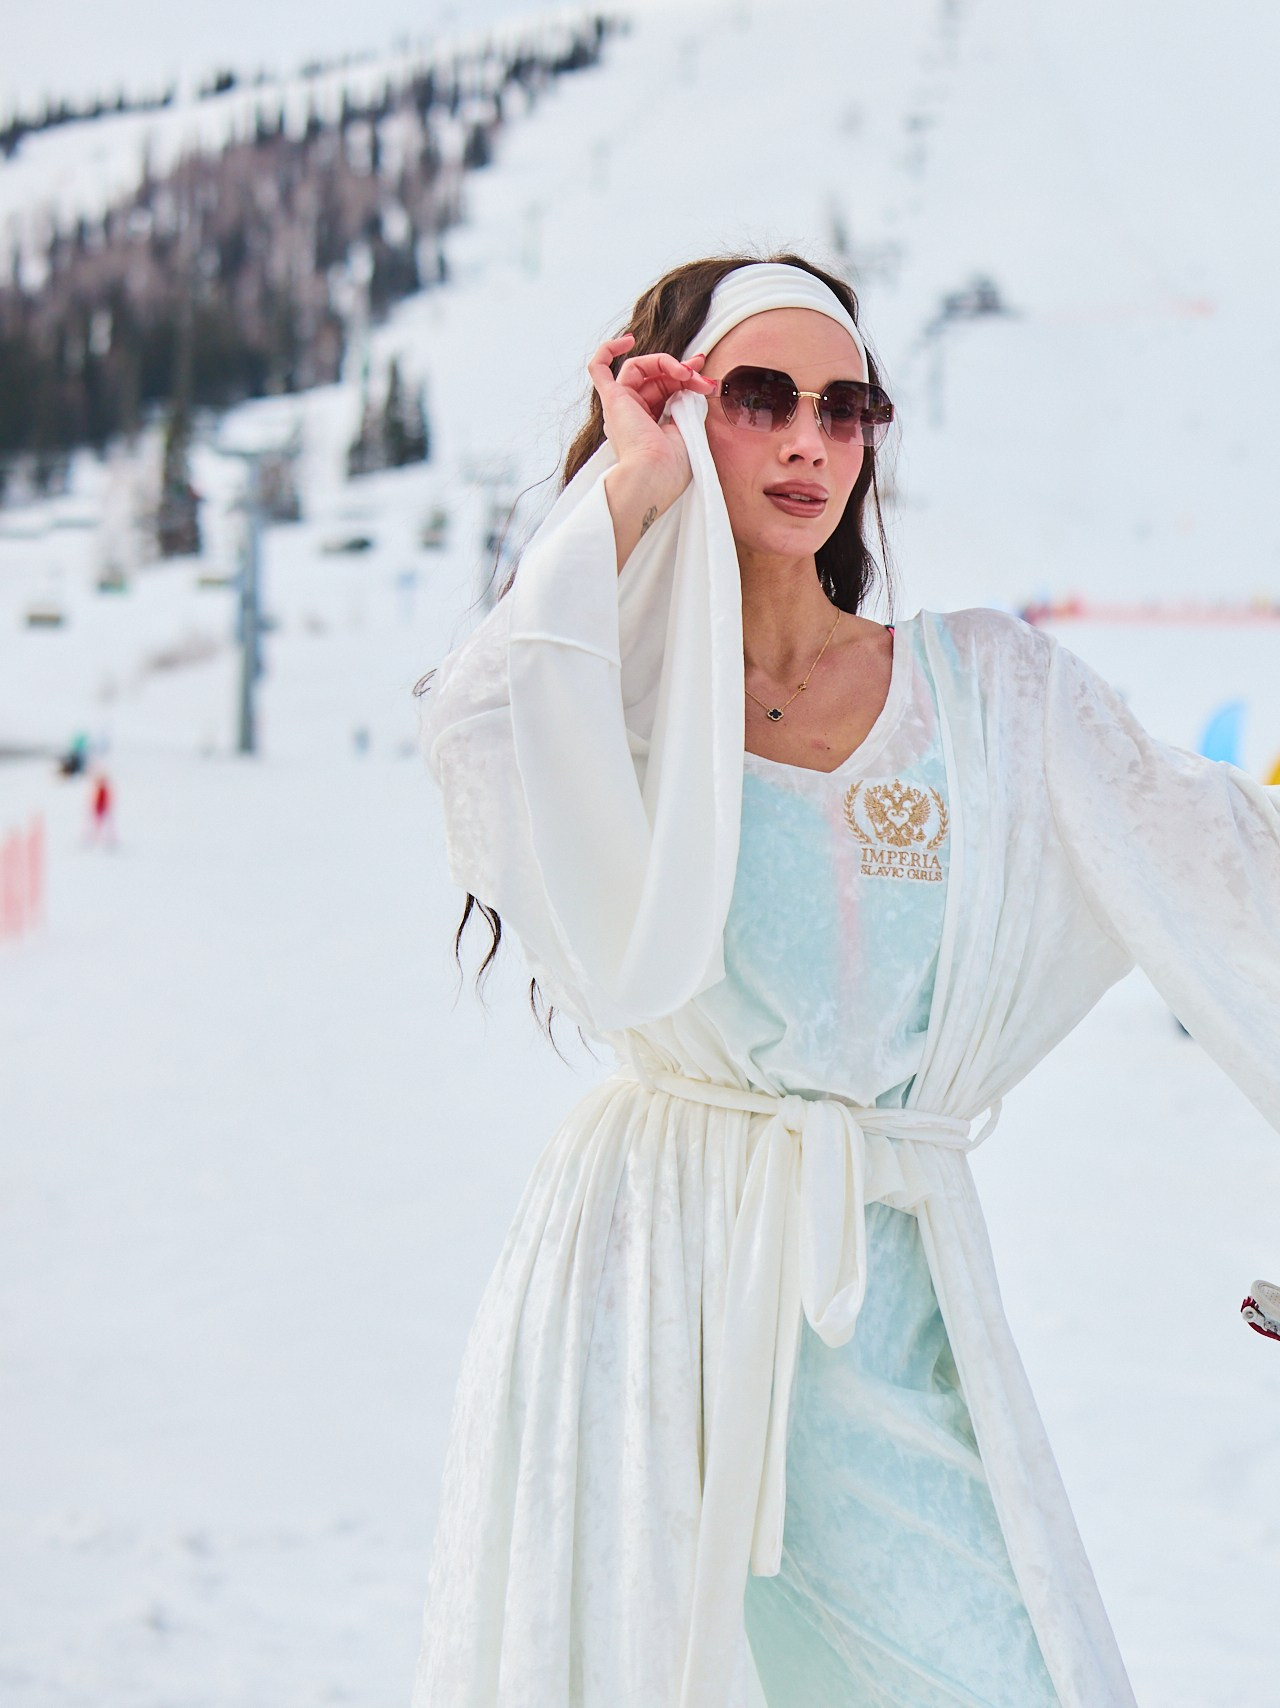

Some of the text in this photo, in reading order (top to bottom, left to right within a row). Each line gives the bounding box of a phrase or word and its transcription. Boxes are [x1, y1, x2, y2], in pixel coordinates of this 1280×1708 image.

[861, 848, 942, 870] IMPERIA
[861, 864, 943, 882] SLAVIC GIRLS
